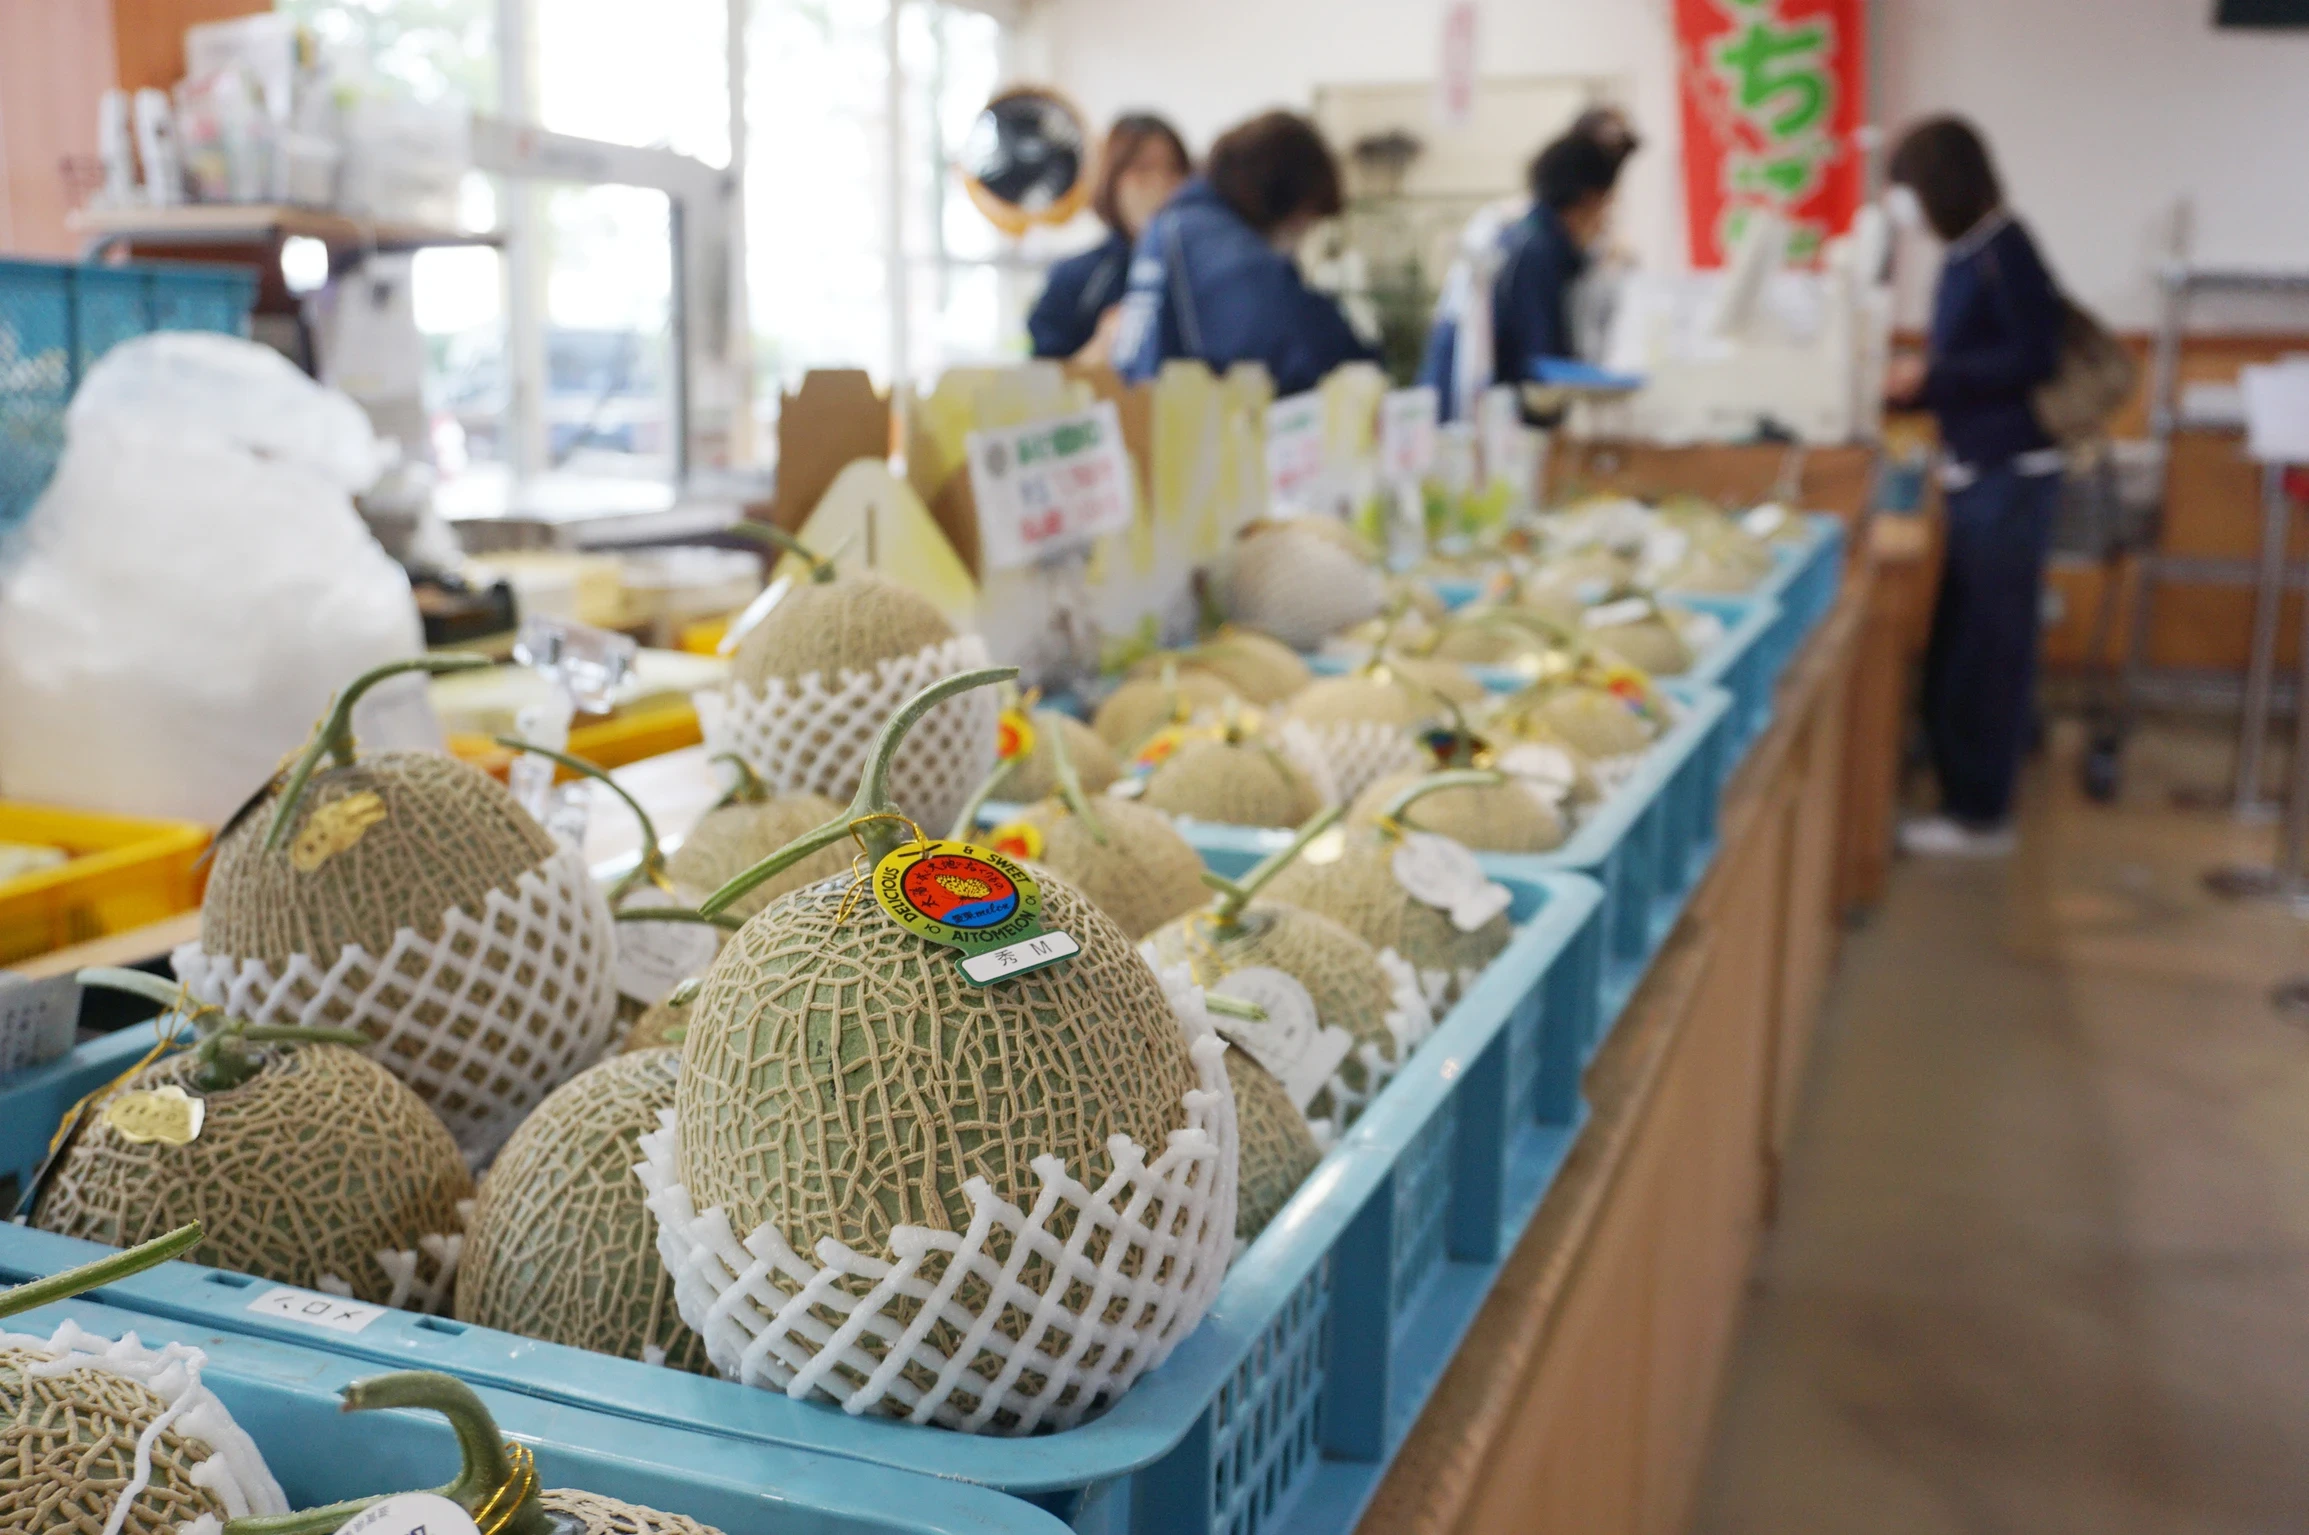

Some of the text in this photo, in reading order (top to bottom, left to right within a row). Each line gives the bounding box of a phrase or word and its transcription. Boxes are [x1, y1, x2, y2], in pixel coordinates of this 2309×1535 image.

[881, 846, 1032, 923] DELICIOUS & SWEET
[994, 940, 1053, 967] 秀 M
